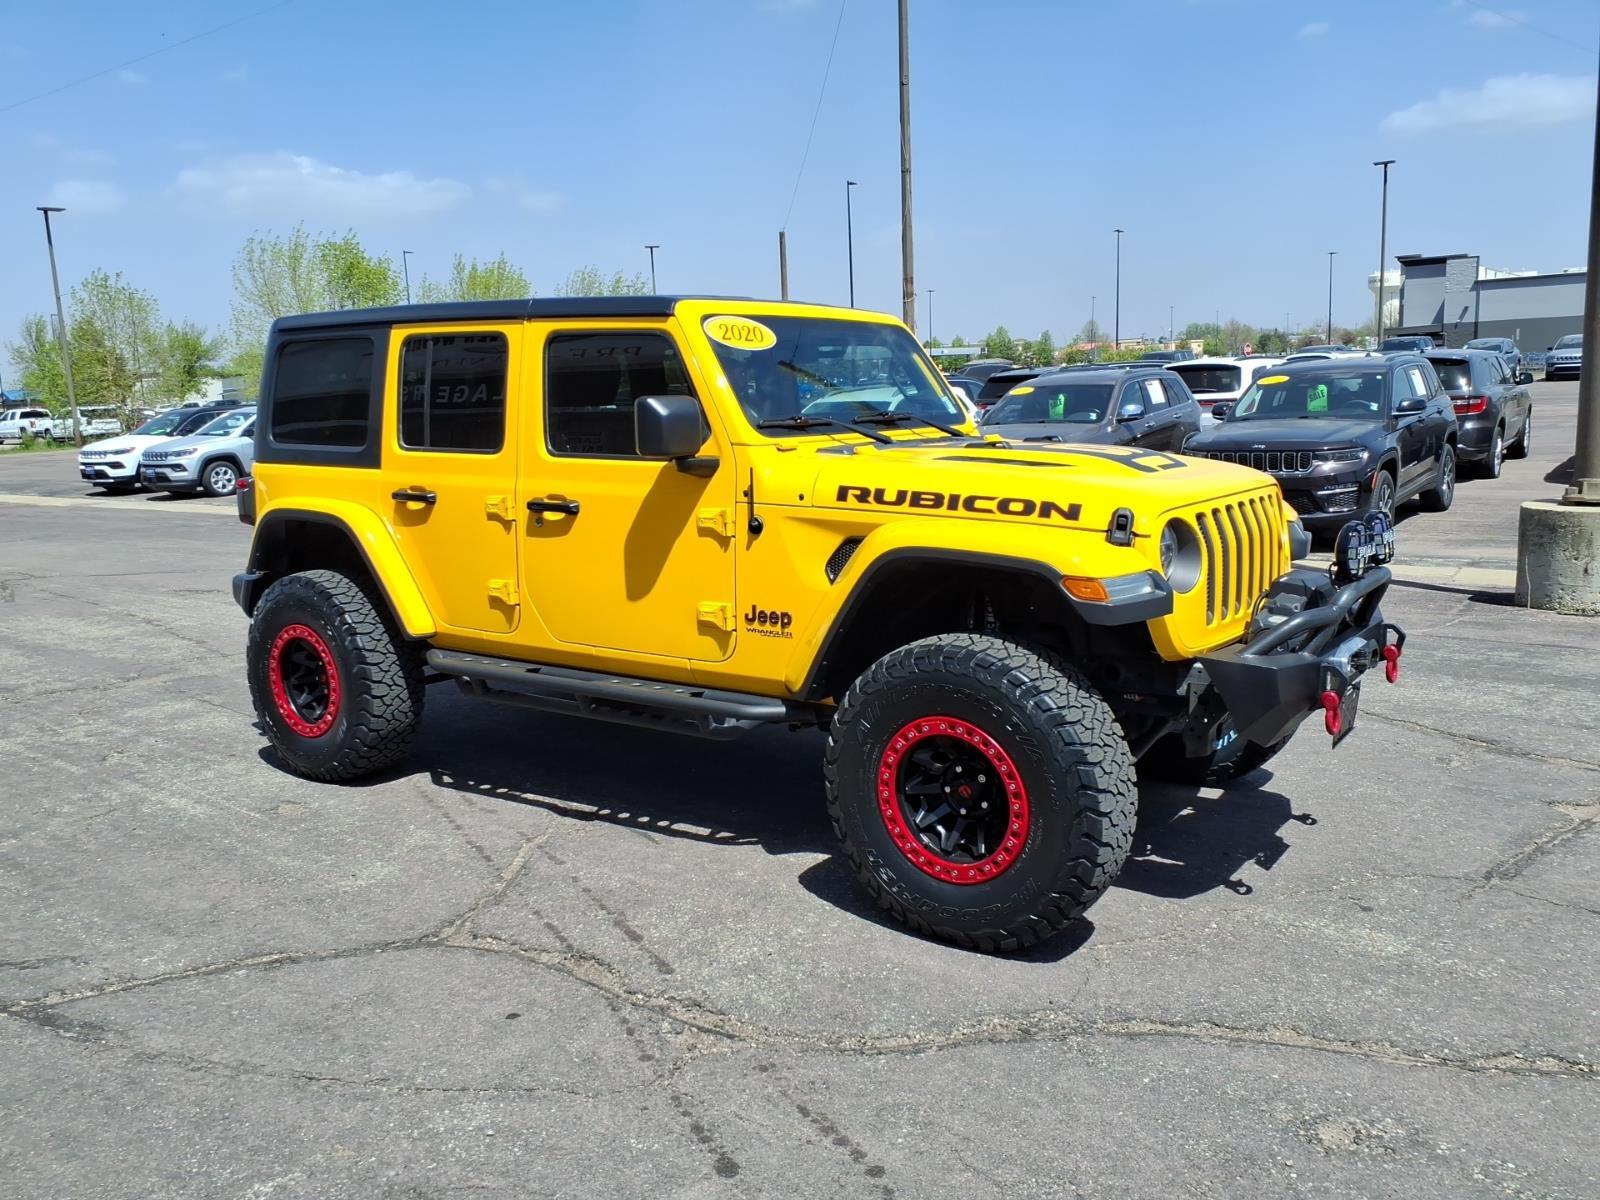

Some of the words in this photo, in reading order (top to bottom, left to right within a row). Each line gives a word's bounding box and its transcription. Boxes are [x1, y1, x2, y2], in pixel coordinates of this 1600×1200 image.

[719, 323, 764, 343] 2020
[1309, 390, 1325, 402] SALE
[836, 485, 1082, 522] RUBICON
[744, 604, 793, 630] Jeep
[746, 627, 793, 638] WRANGLER
